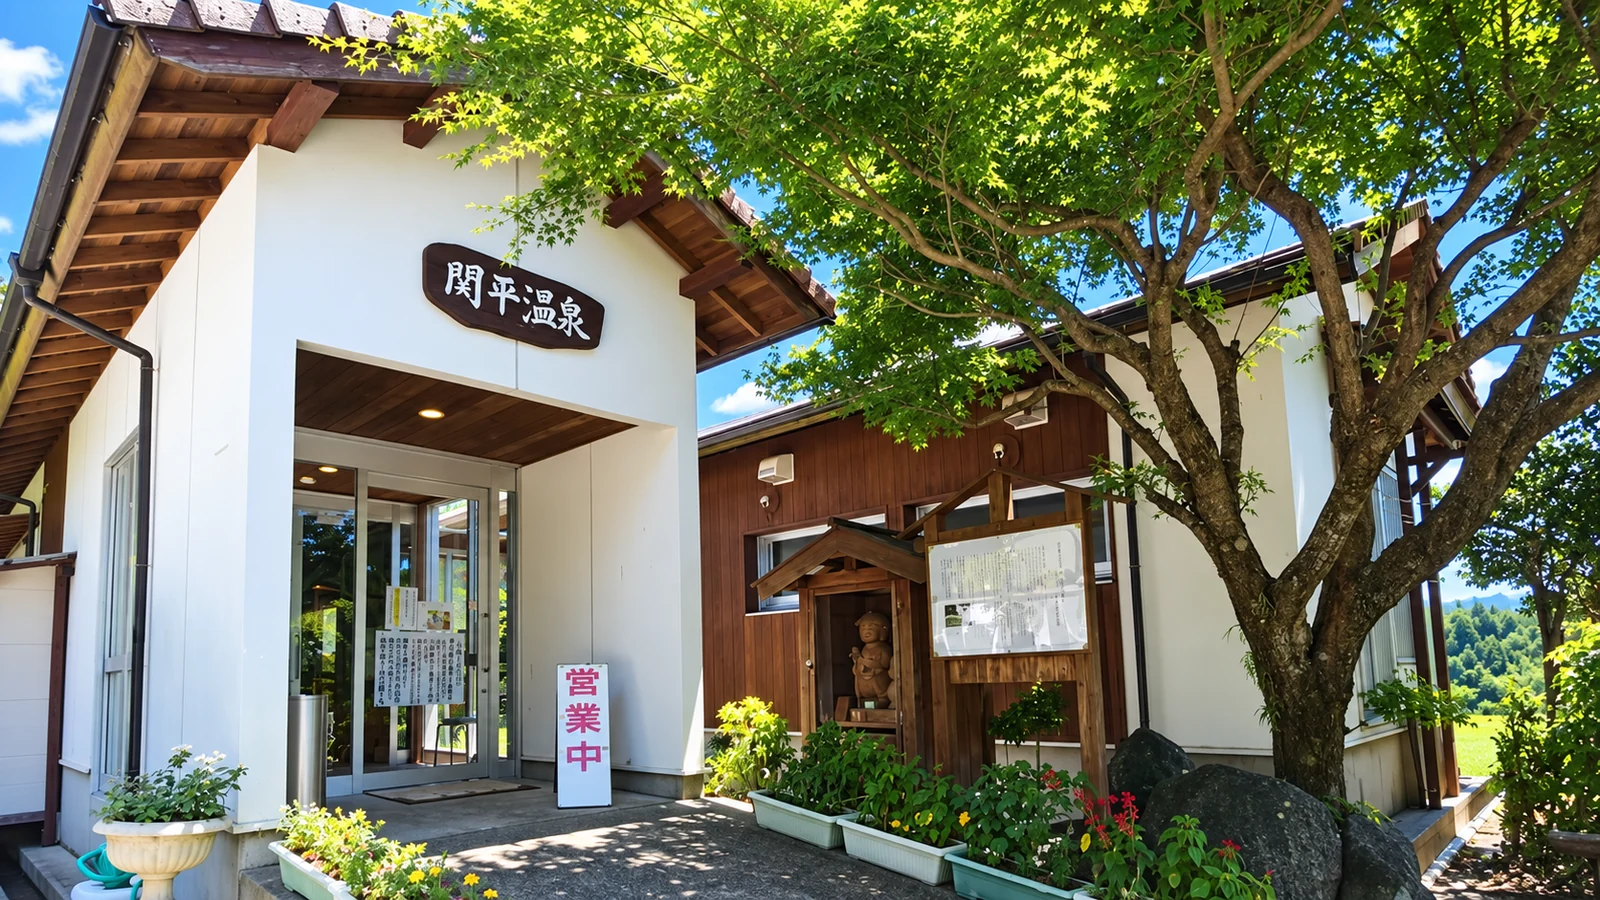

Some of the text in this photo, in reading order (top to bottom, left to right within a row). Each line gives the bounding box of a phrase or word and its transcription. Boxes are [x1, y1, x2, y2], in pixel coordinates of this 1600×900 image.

[444, 261, 591, 340] 関平温泉
[565, 668, 601, 772] 営業中
